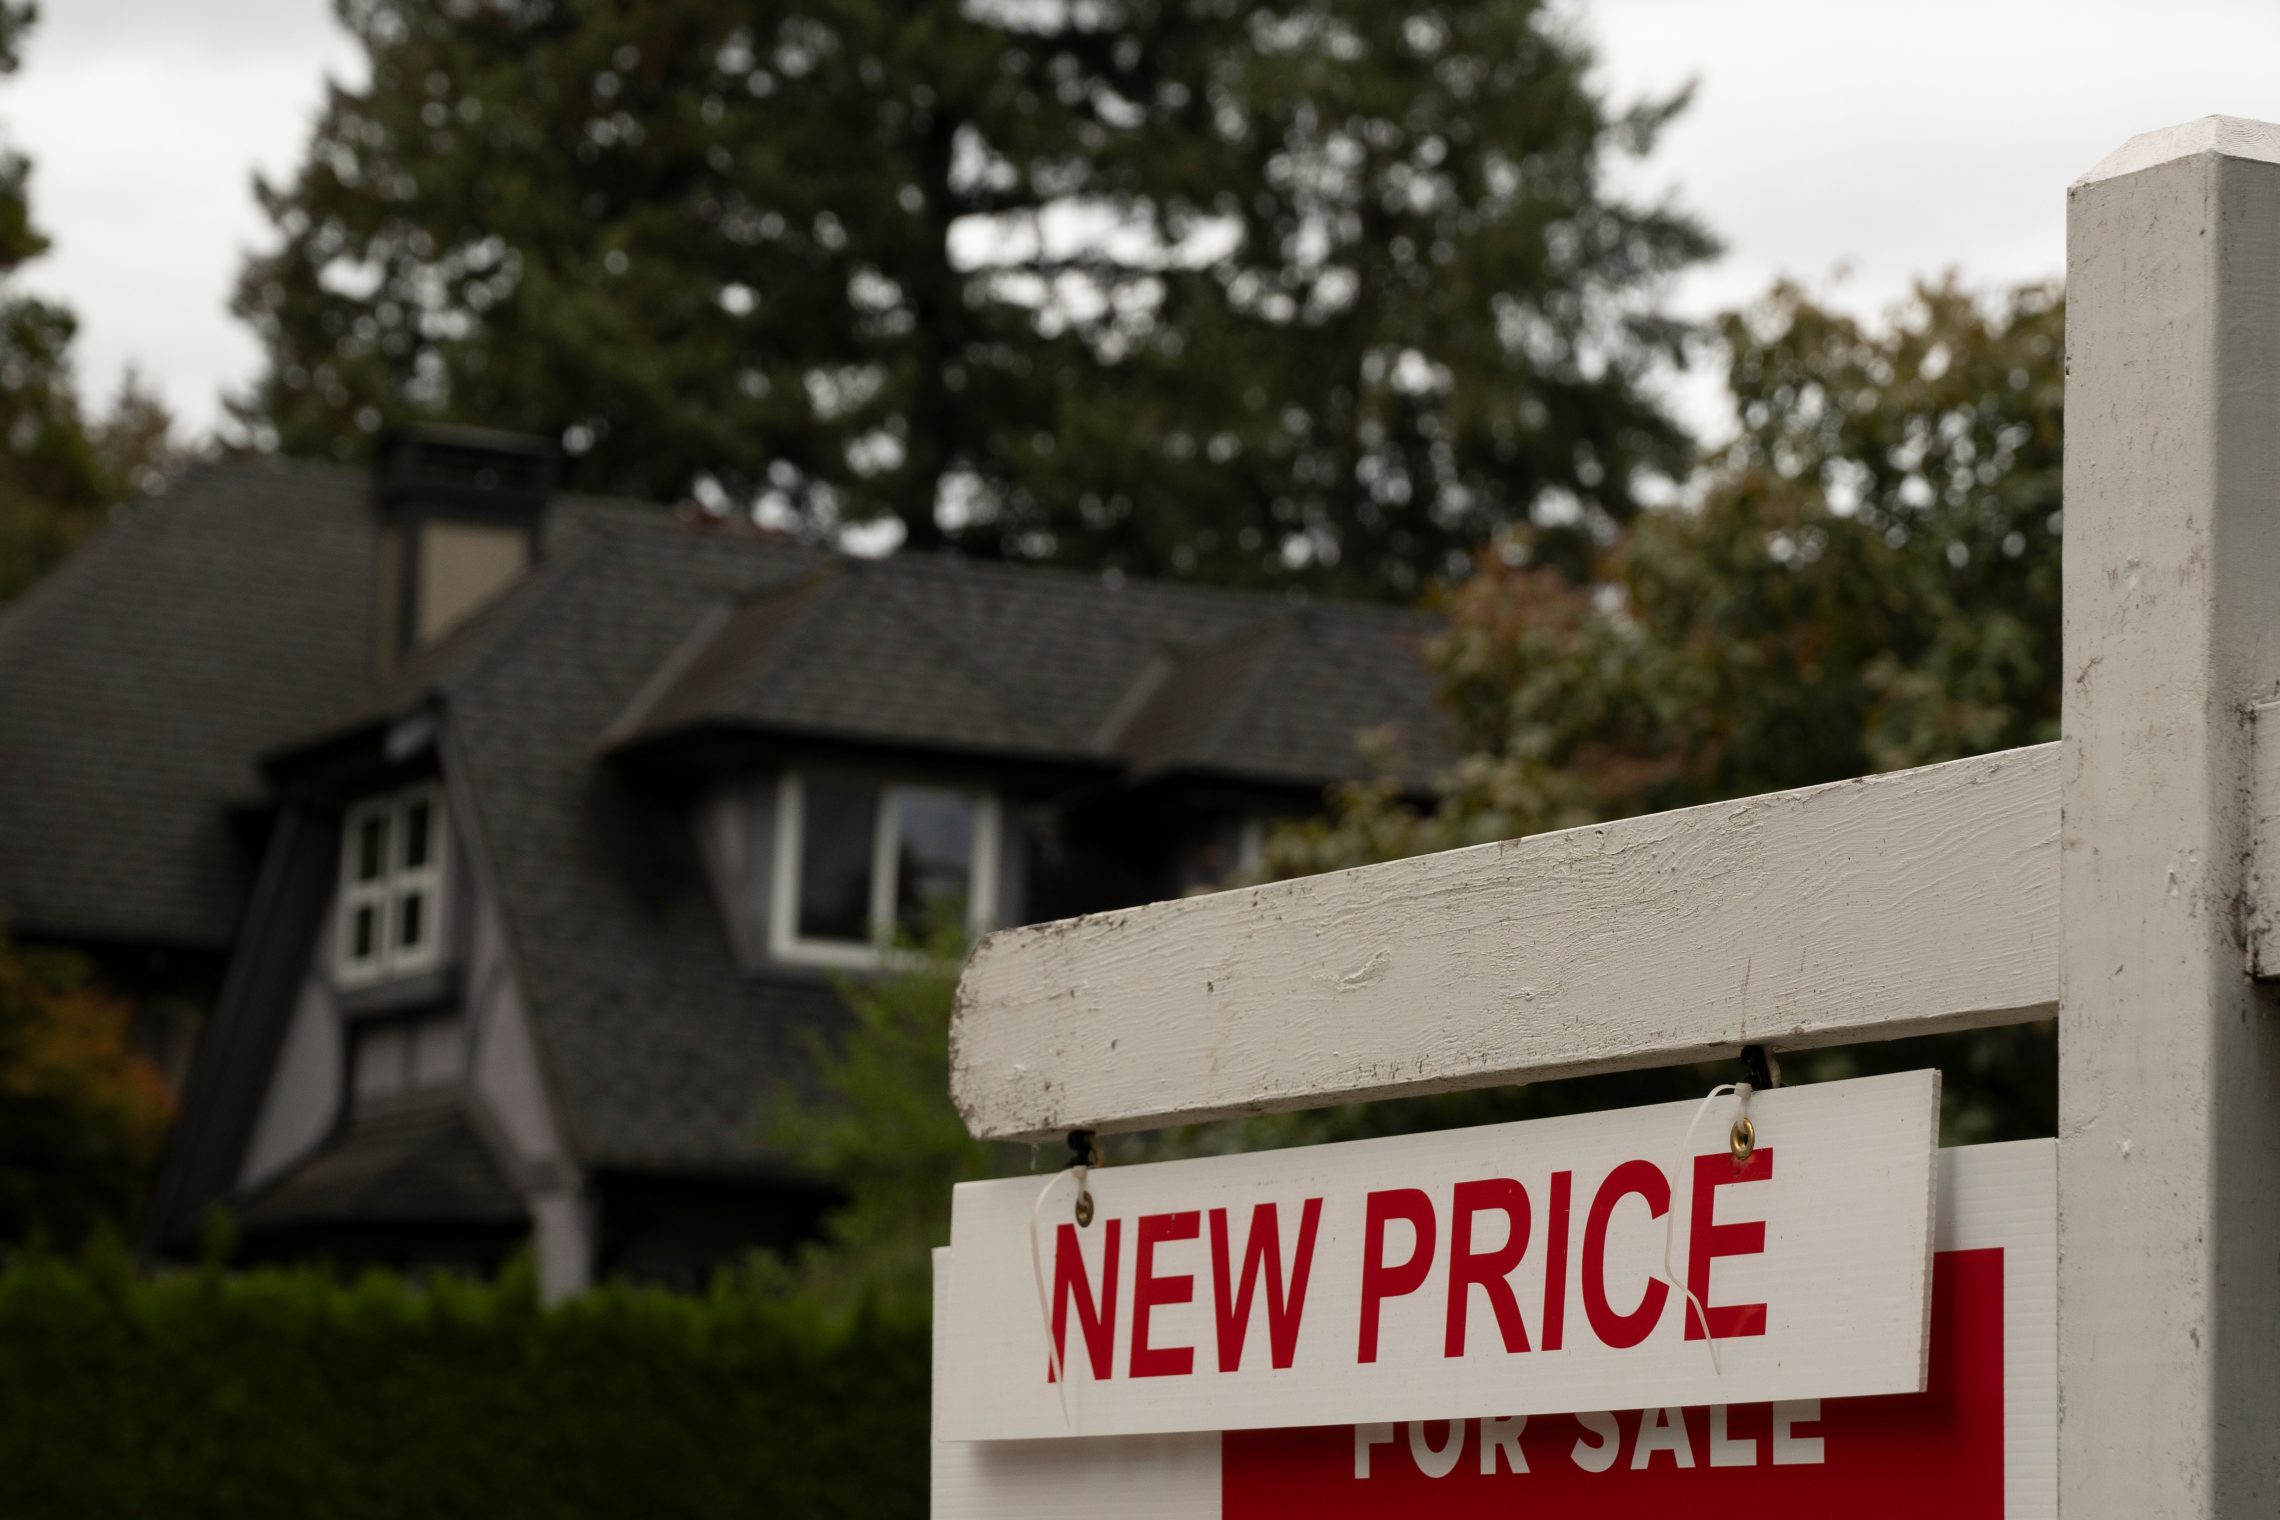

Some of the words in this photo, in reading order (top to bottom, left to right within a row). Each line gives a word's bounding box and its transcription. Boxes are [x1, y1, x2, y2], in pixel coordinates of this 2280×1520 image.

[1047, 1196, 1323, 1384] NEW
[1356, 1147, 1774, 1364] PRICE
[1570, 1398, 1825, 1474] SALE
